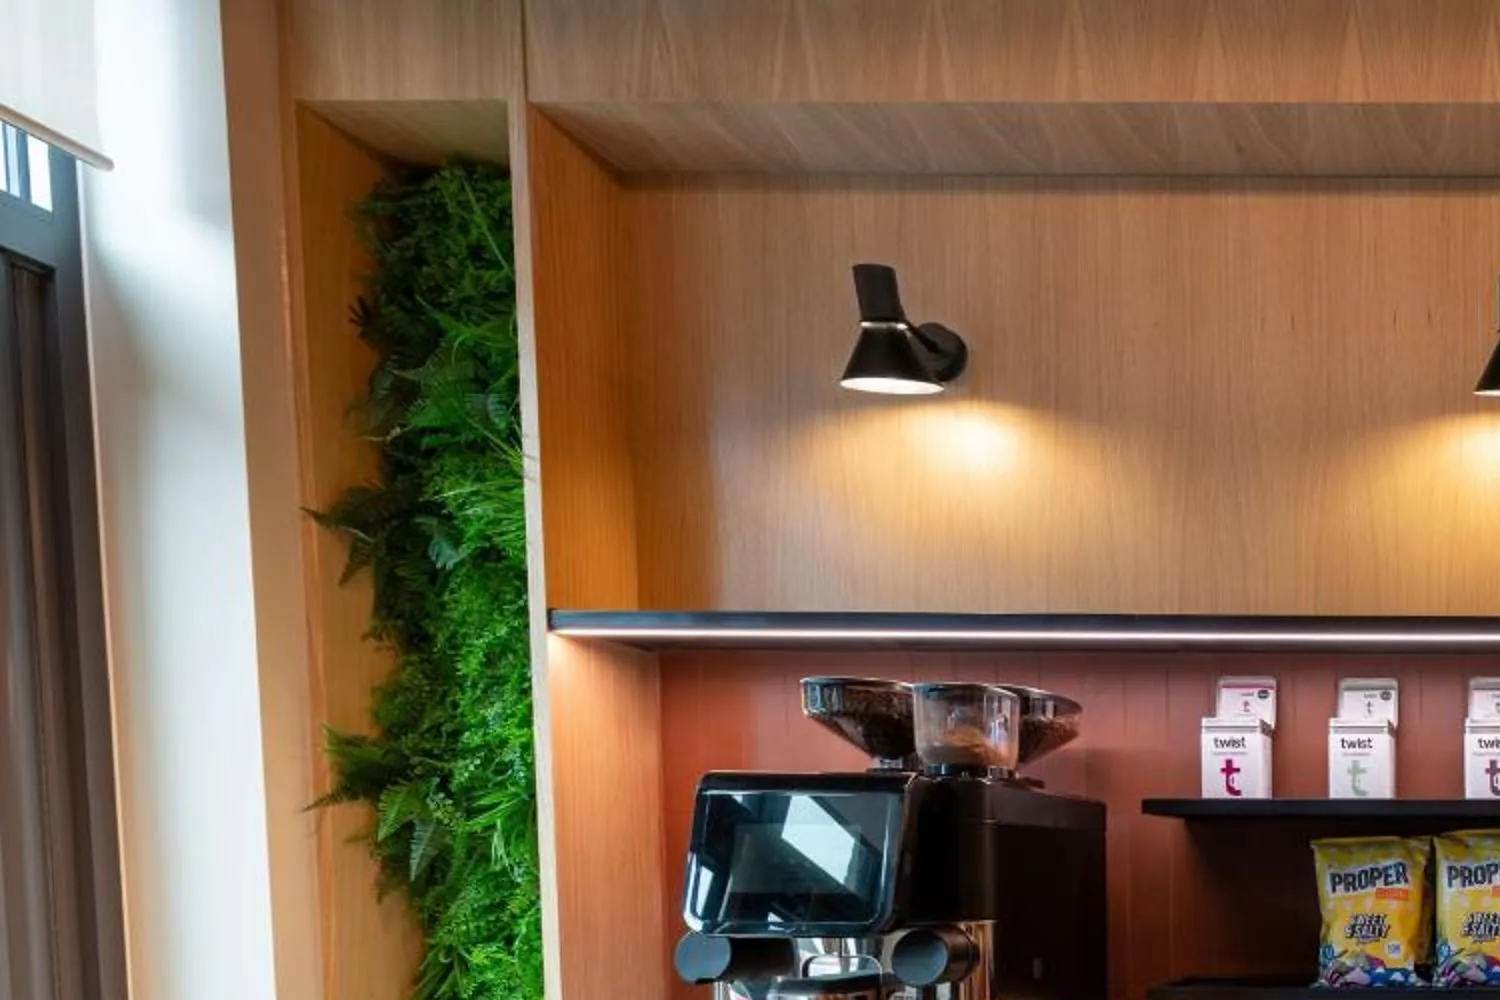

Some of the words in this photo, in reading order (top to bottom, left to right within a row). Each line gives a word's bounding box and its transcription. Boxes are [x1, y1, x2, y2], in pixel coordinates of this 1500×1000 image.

[1213, 736, 1247, 749] twist
[1341, 737, 1373, 749] twist
[1220, 759, 1242, 796] t
[1348, 760, 1367, 796] t
[1330, 862, 1409, 893] PROPER
